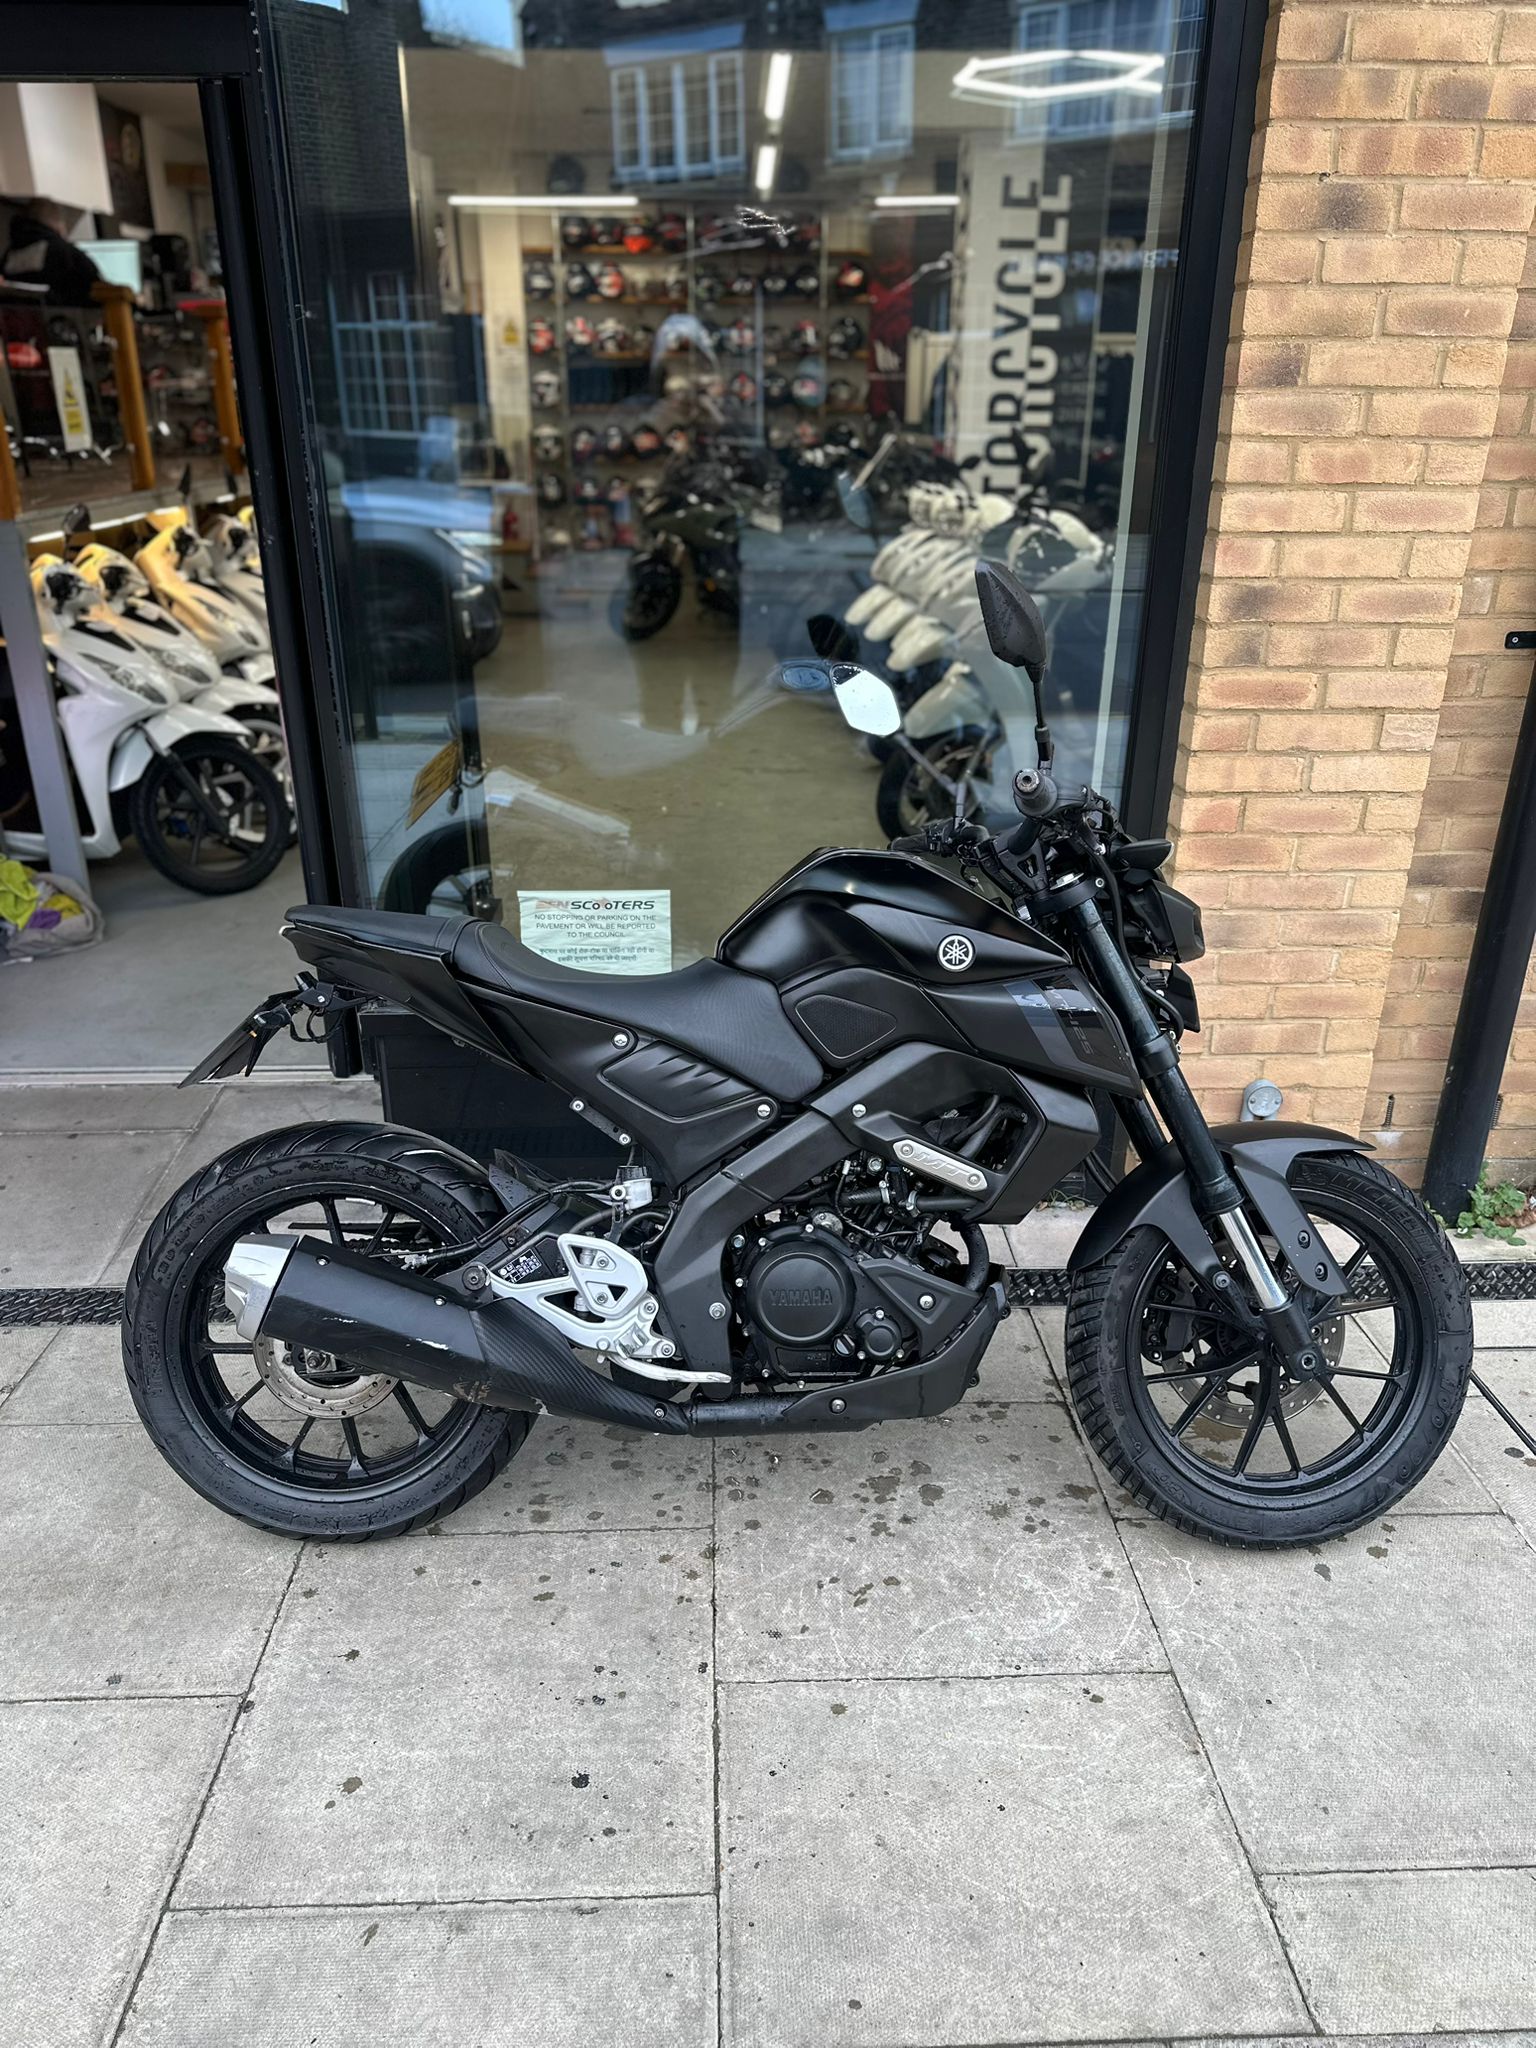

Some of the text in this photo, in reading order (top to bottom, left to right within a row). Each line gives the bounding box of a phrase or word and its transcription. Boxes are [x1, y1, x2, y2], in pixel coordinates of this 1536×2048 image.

[536, 922, 574, 930] PAVEMENT
[575, 922, 586, 930] OR
[606, 922, 616, 930] BE
[617, 922, 656, 930] REPORTED
[913, 1151, 970, 1177] MT
[769, 1287, 833, 1306] YAMAHA
